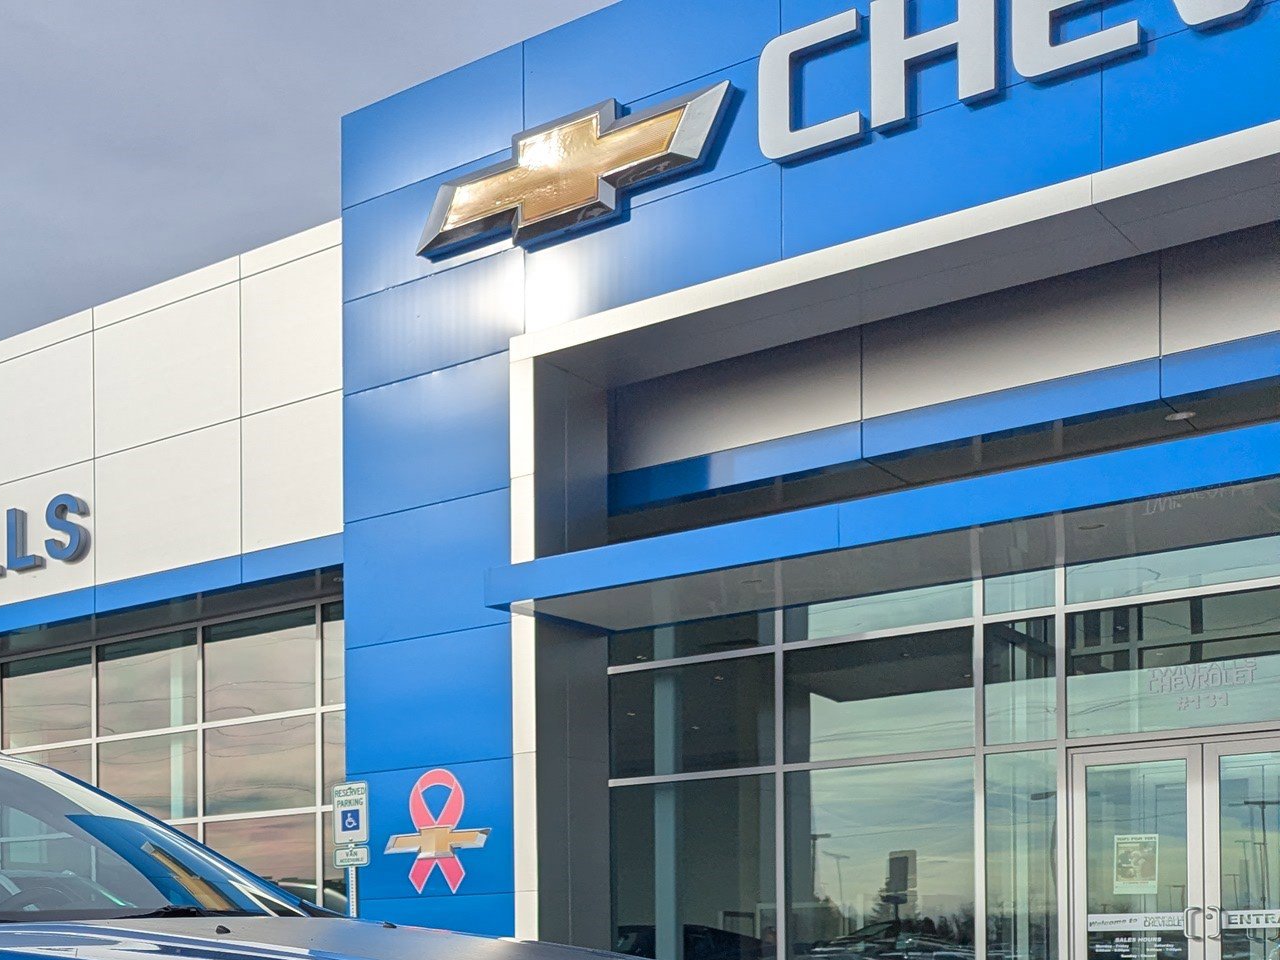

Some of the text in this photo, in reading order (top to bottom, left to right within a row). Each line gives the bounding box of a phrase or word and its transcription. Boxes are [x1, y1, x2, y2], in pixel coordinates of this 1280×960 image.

[1149, 667, 1258, 695] CHEVROLET
[334, 787, 365, 798] RESERVED
[337, 798, 364, 808] PARKING
[1089, 918, 1127, 928] Welcome
[1228, 913, 1280, 925] ENTR
